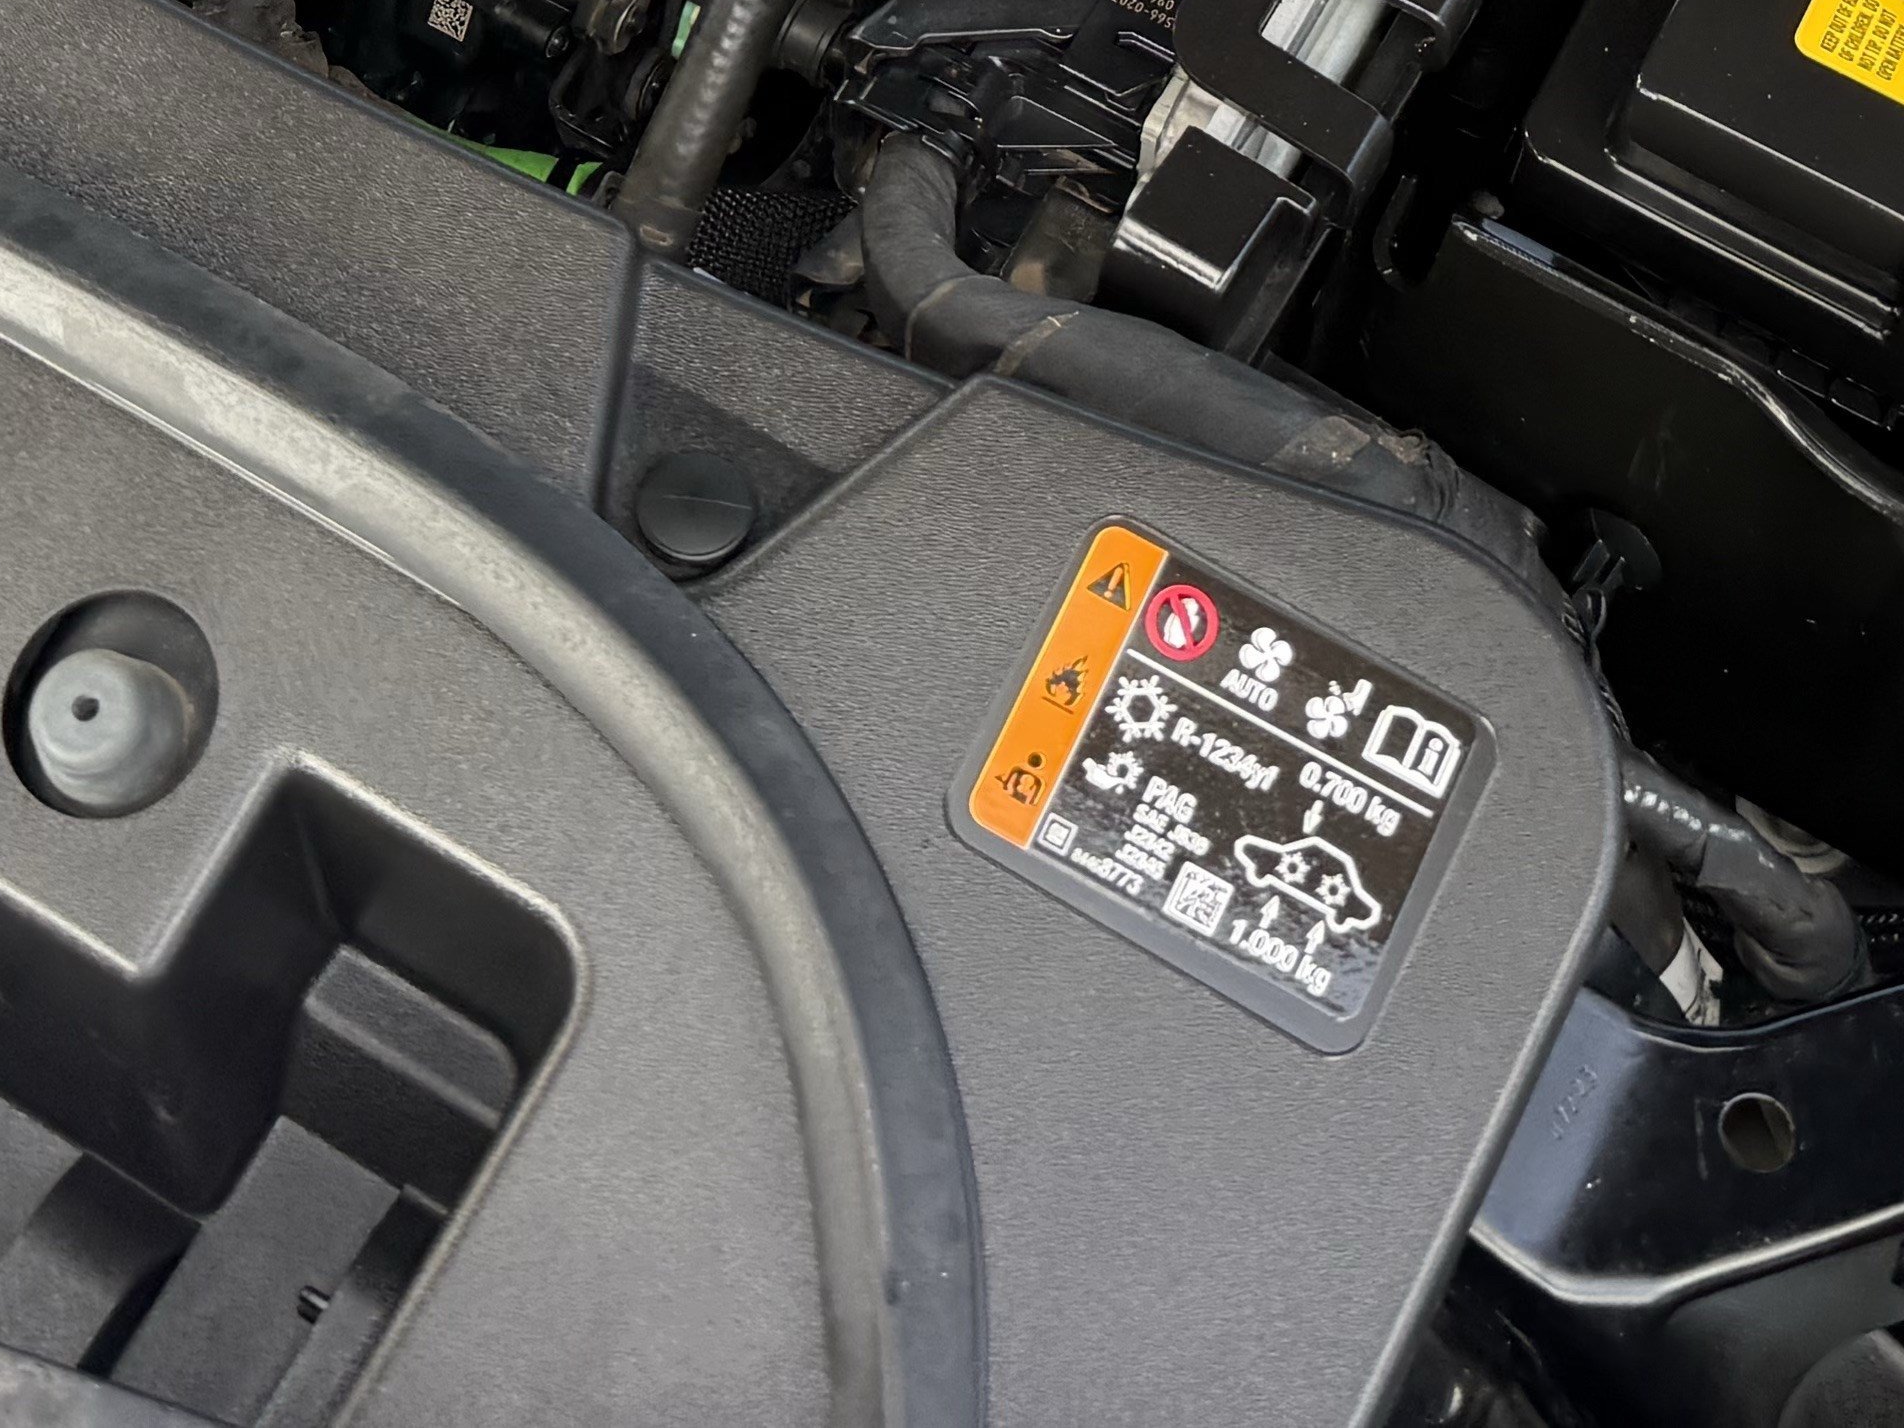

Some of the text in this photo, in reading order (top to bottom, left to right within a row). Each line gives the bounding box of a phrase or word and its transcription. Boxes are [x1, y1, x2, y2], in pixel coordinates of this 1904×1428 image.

[1835, 2, 1853, 18] OF
[1877, 8, 1897, 28] NOT
[1828, 13, 1847, 34] OUT
[1871, 24, 1890, 40] DO
[1837, 46, 1855, 62] OF
[1856, 51, 1877, 71] NOT
[1875, 56, 1898, 81] OPEN
[1220, 668, 1278, 711] AUTO
[1142, 775, 1196, 823] PAG
[1299, 761, 1400, 836] 0.700 kg
[1132, 803, 1169, 833] SAE
[1229, 918, 1332, 996] 1.000 kg
